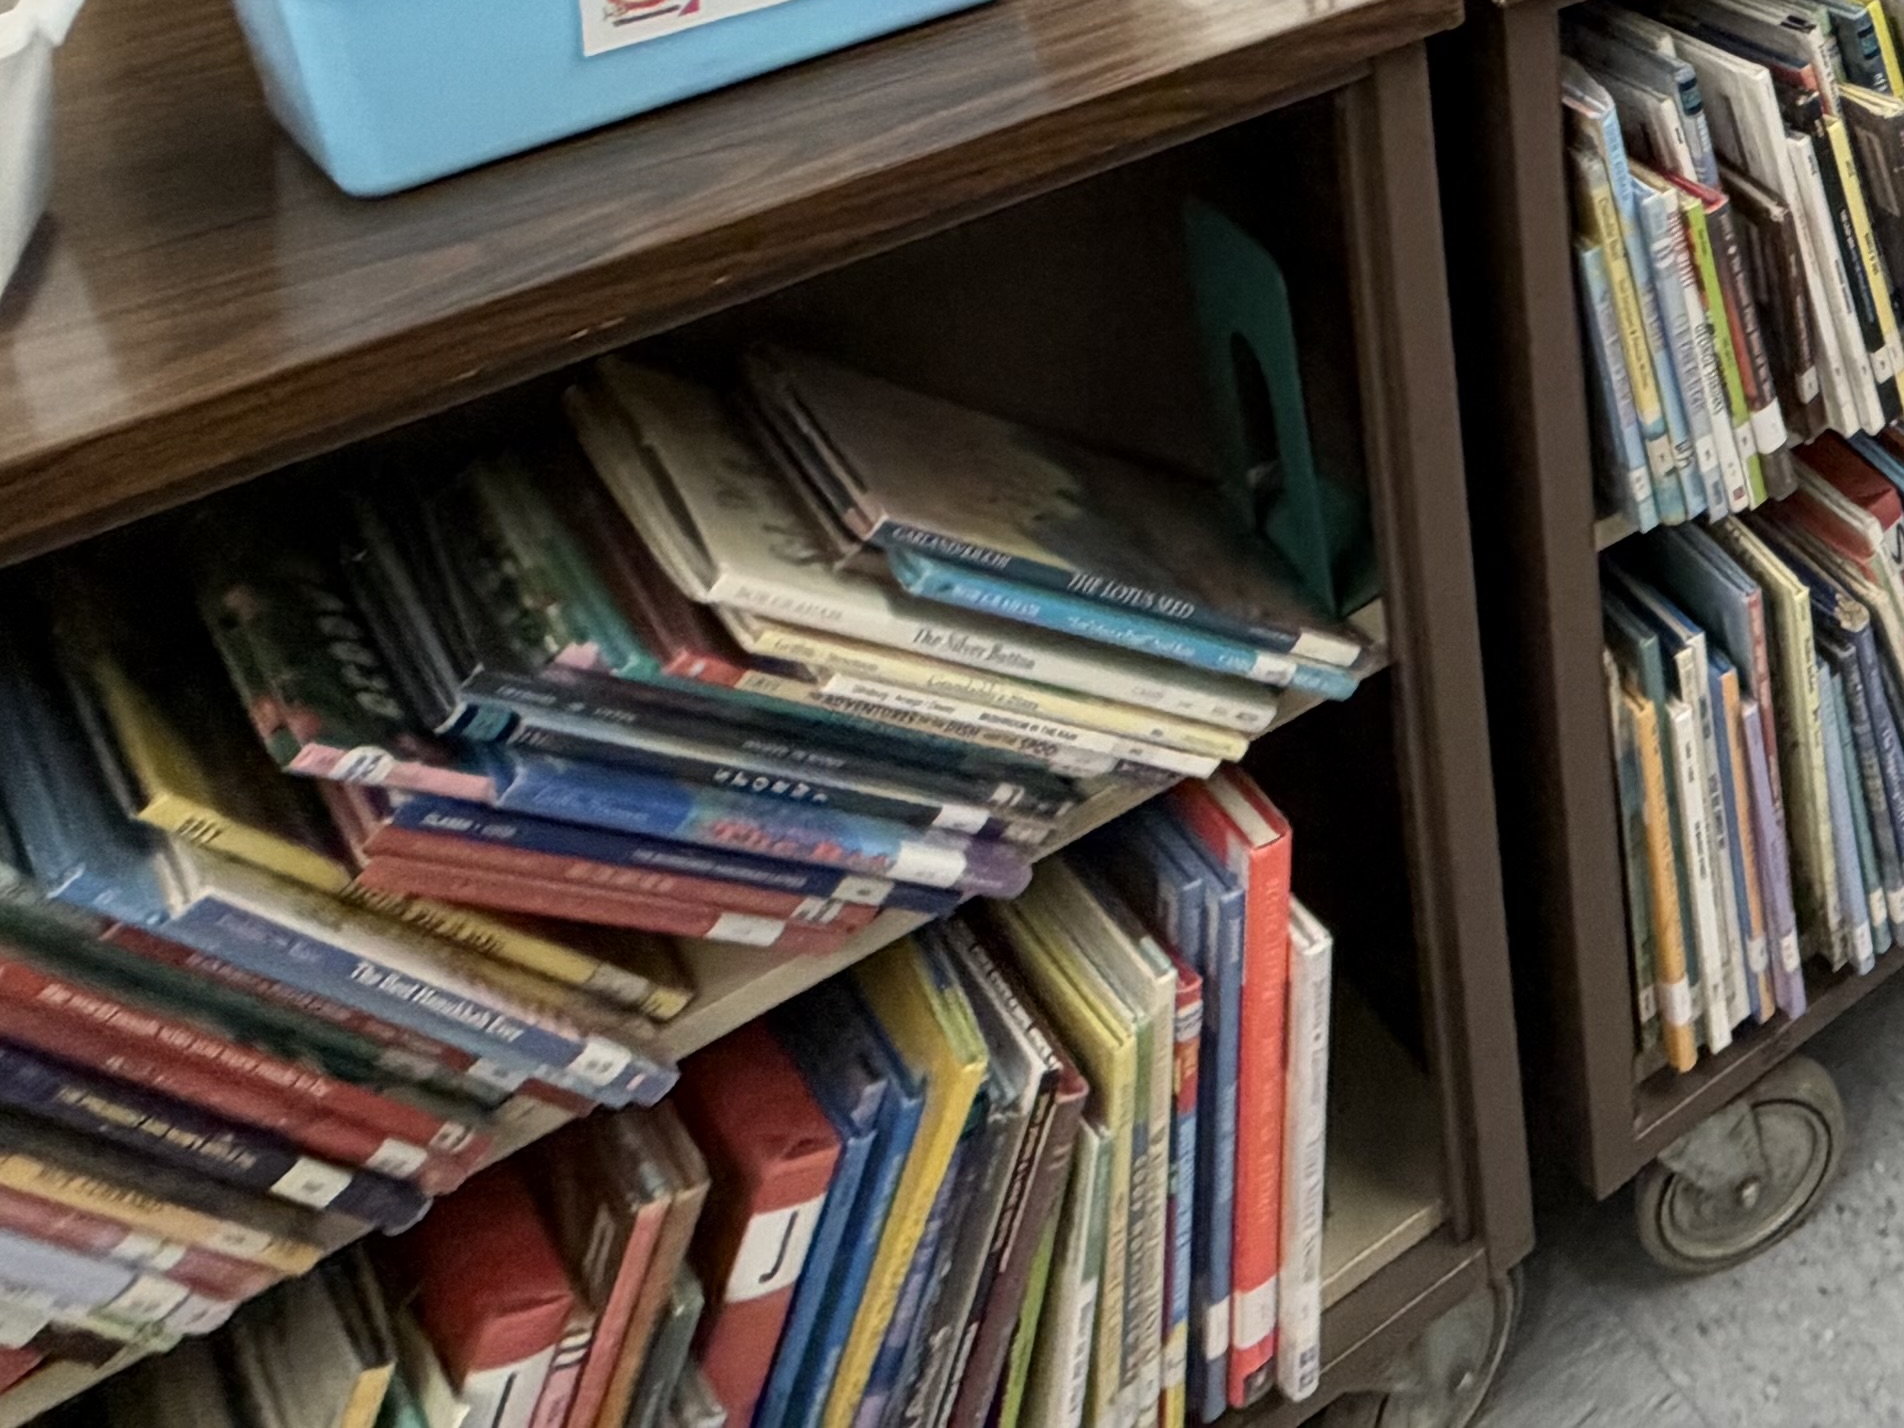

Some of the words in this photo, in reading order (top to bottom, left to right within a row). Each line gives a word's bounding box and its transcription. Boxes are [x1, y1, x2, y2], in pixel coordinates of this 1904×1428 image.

[1067, 570, 1101, 593] THE
[1101, 579, 1154, 611] LOTUS
[1157, 594, 1195, 620] SEED
[913, 626, 946, 648] The
[985, 646, 1037, 672] Button
[820, 693, 918, 726] ADVENTURES
[1019, 736, 1059, 756] SPOO
[351, 960, 381, 987] The
[412, 983, 492, 1033] Hanukkah
[486, 1014, 525, 1043] Ever
[758, 1209, 800, 1284] J
